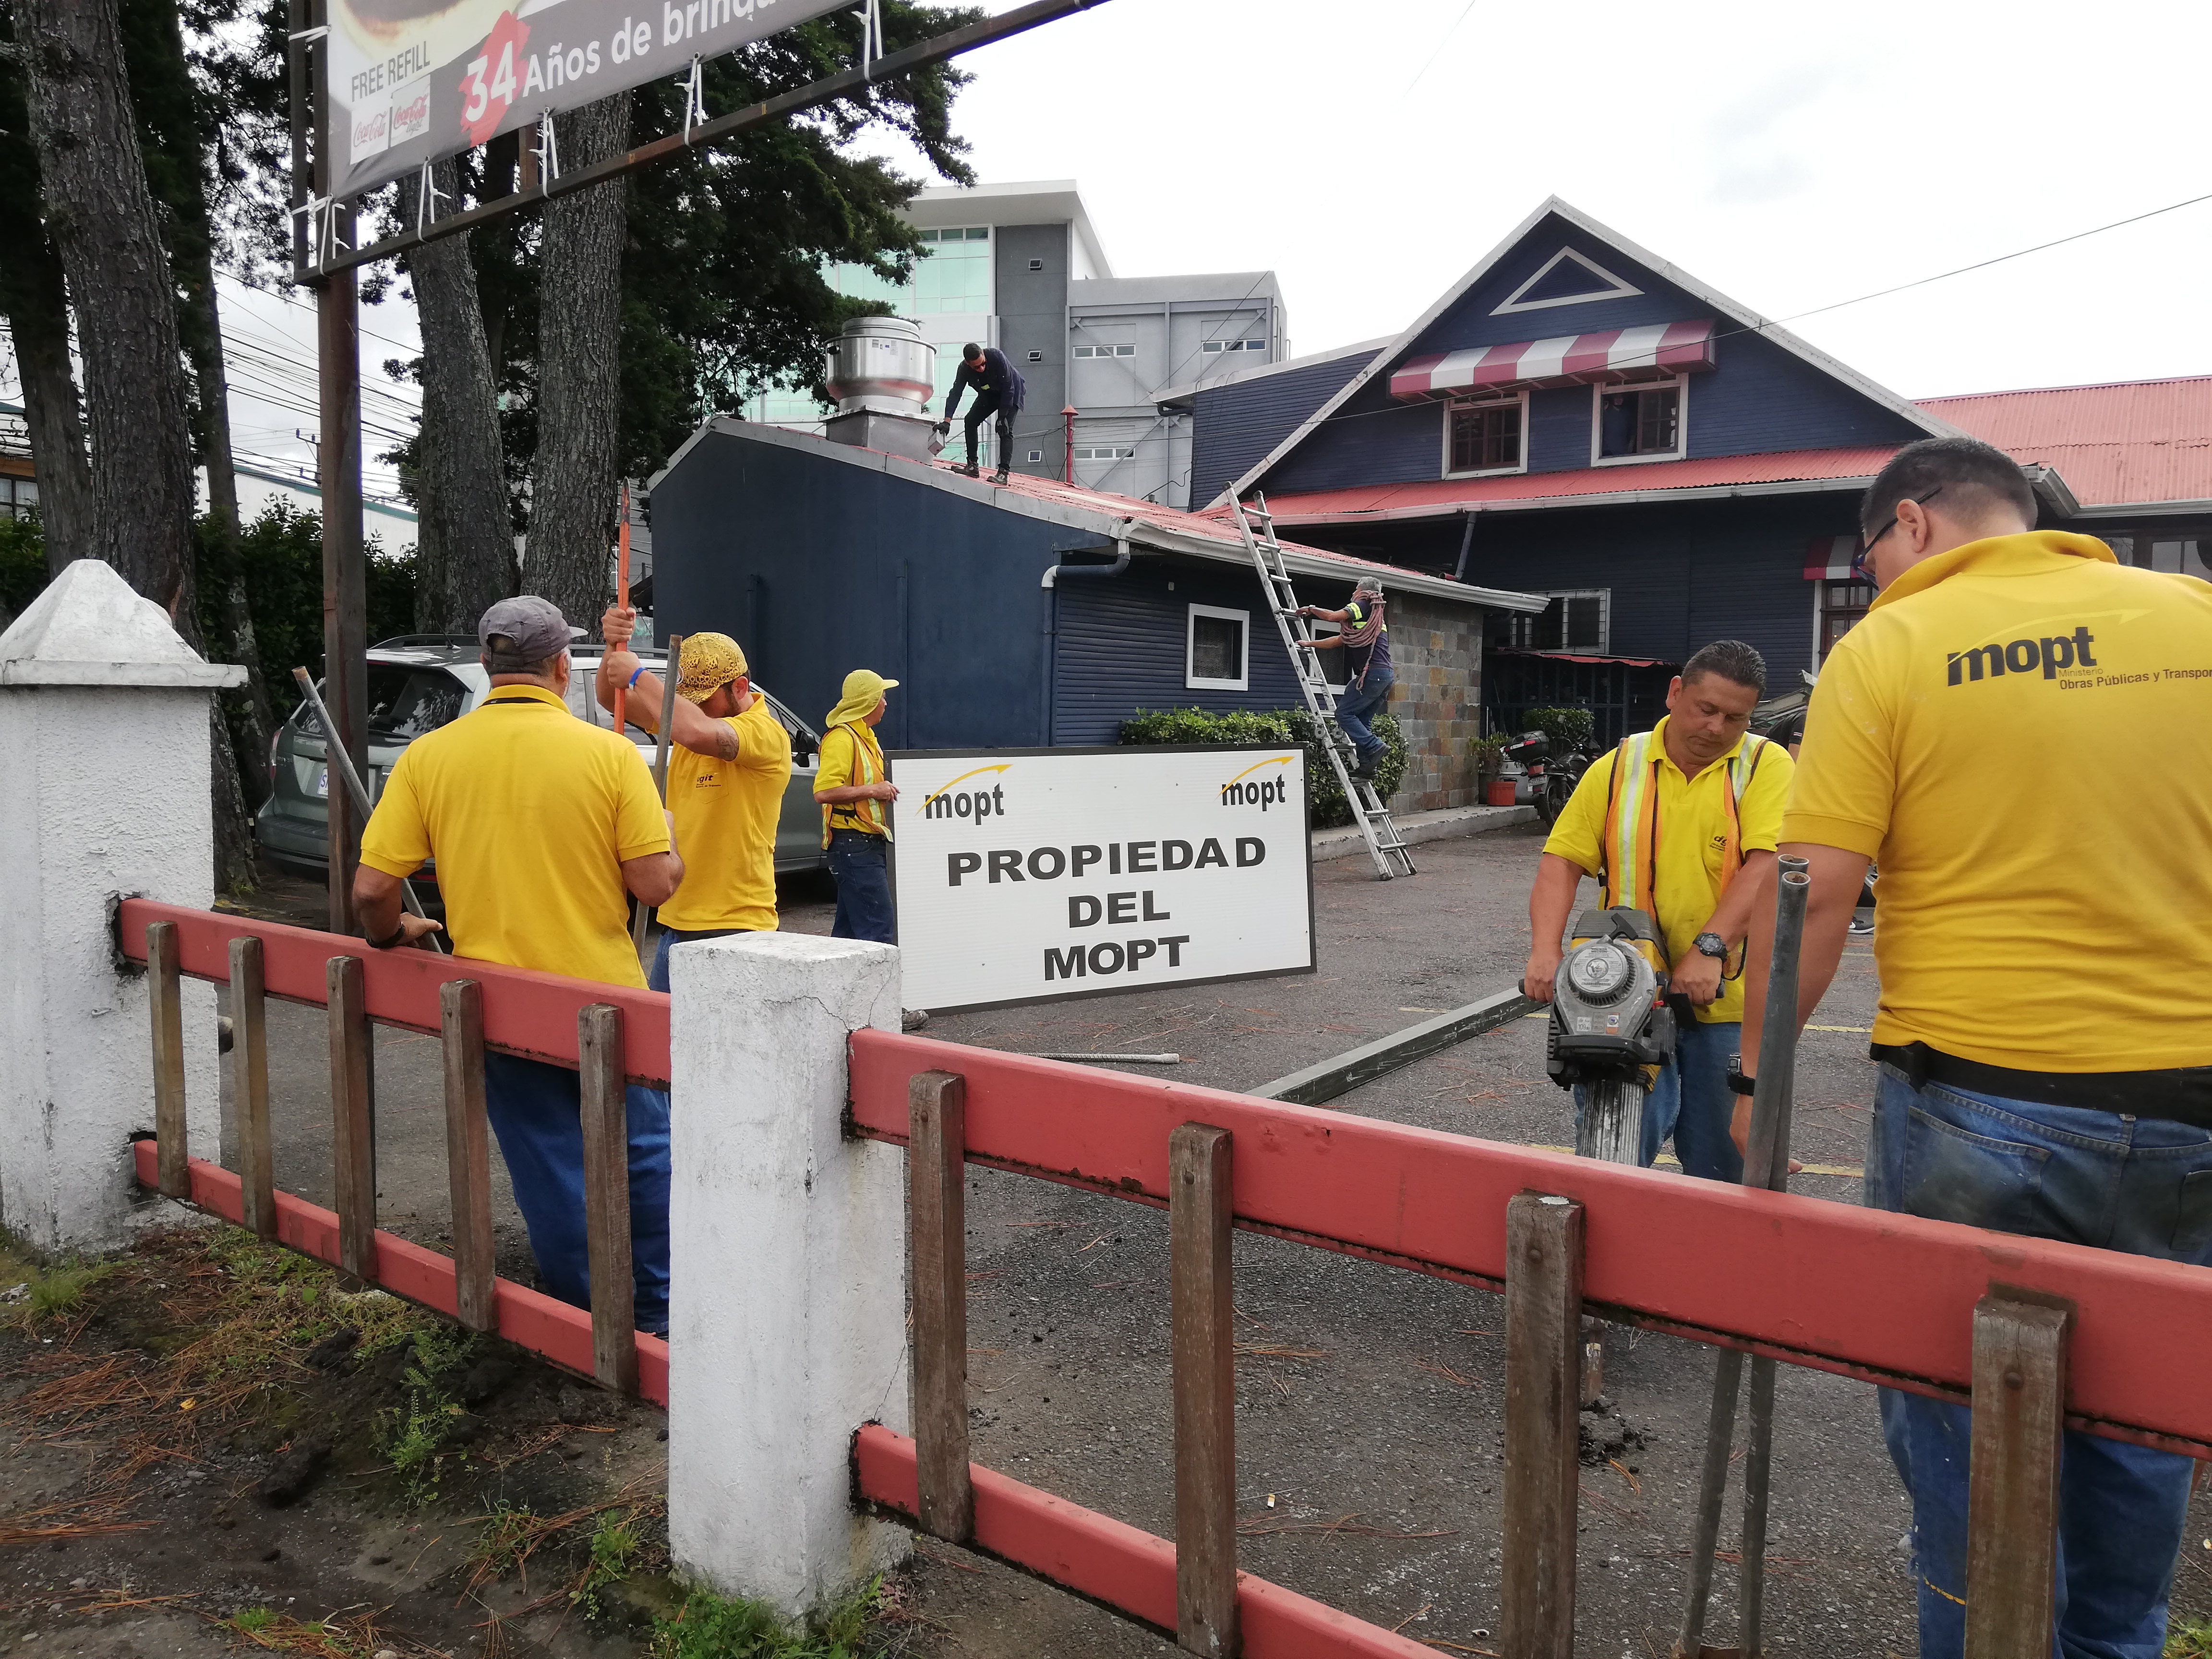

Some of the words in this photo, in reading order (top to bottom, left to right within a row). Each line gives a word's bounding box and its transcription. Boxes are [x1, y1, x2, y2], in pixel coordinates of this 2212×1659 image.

[351, 63, 384, 103] FREE
[388, 40, 431, 85] REFILL
[465, 40, 517, 122] 34
[522, 41, 601, 97] Años
[611, 16, 652, 64] de
[1947, 626, 2098, 687] mopt
[2058, 668, 2104, 678] Ministerio
[2059, 679, 2093, 690] Obras
[2096, 674, 2150, 687] Públicas
[2153, 672, 2160, 682] y
[925, 782, 1005, 826] mopt
[1222, 773, 1286, 812] mopt
[948, 837, 1266, 887] PROPIEDAD
[1068, 890, 1171, 928] DEL
[1044, 935, 1190, 981] MOPT
